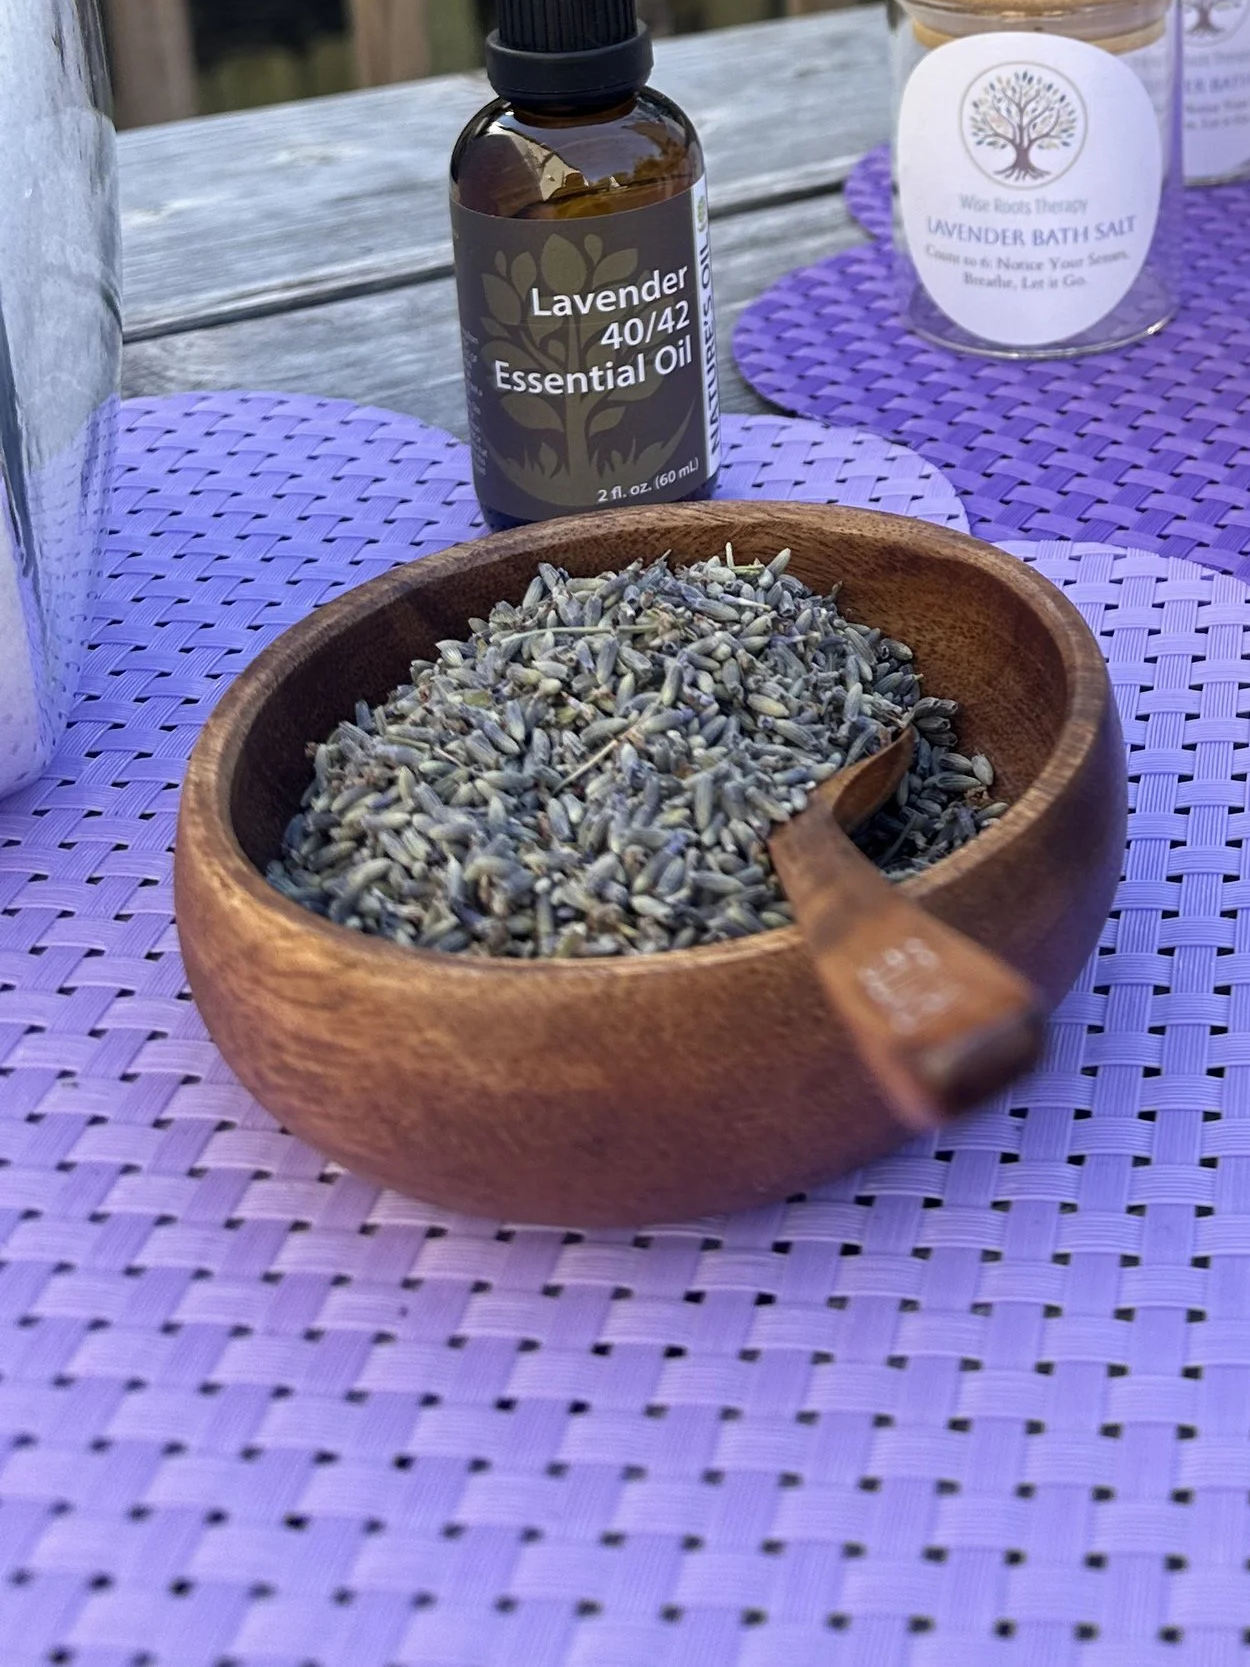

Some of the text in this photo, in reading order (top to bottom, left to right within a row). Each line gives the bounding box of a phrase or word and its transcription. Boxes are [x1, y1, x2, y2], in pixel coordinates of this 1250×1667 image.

[958, 193, 1088, 216] Wise Roots Therapy
[927, 215, 1137, 247] LAVENDER BATH SALT
[997, 257, 1045, 271] Notice
[1049, 255, 1085, 269] Your
[532, 265, 688, 316] Lavender
[1021, 277, 1045, 290] Let
[1049, 276, 1060, 289] it
[601, 300, 690, 350] 40/42
[495, 335, 692, 394] Essential Oil
[598, 457, 700, 502] 2 fl. oz. (60 mL)
